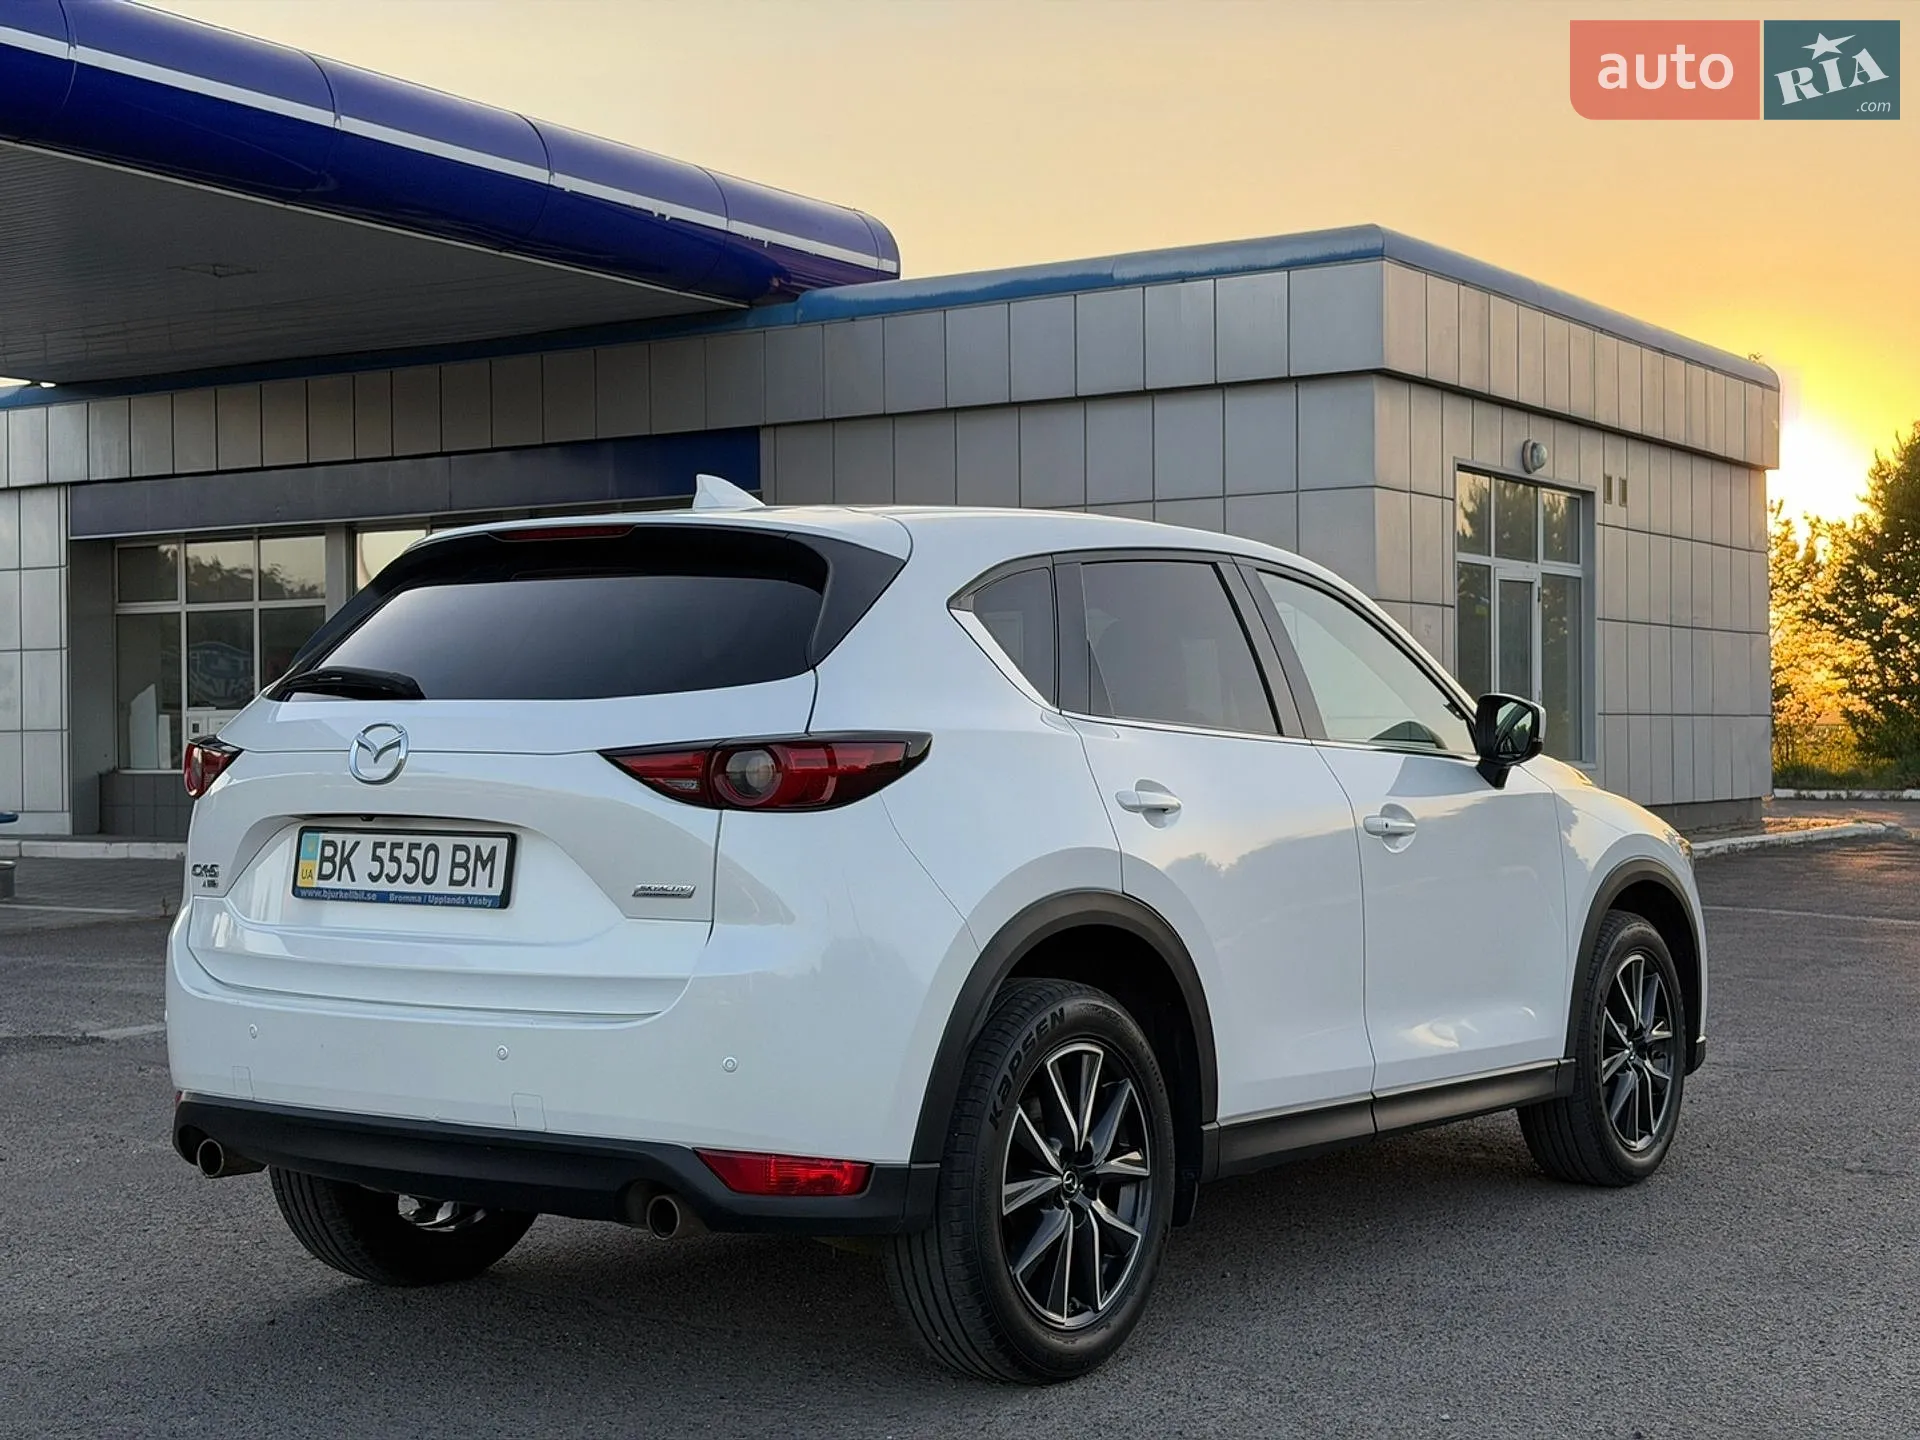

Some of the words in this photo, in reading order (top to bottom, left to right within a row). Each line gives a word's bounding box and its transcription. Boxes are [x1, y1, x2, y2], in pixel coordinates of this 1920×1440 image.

[301, 868, 314, 880] UA
[317, 839, 361, 882] BK
[367, 841, 440, 885] 5550
[448, 844, 497, 888] BM
